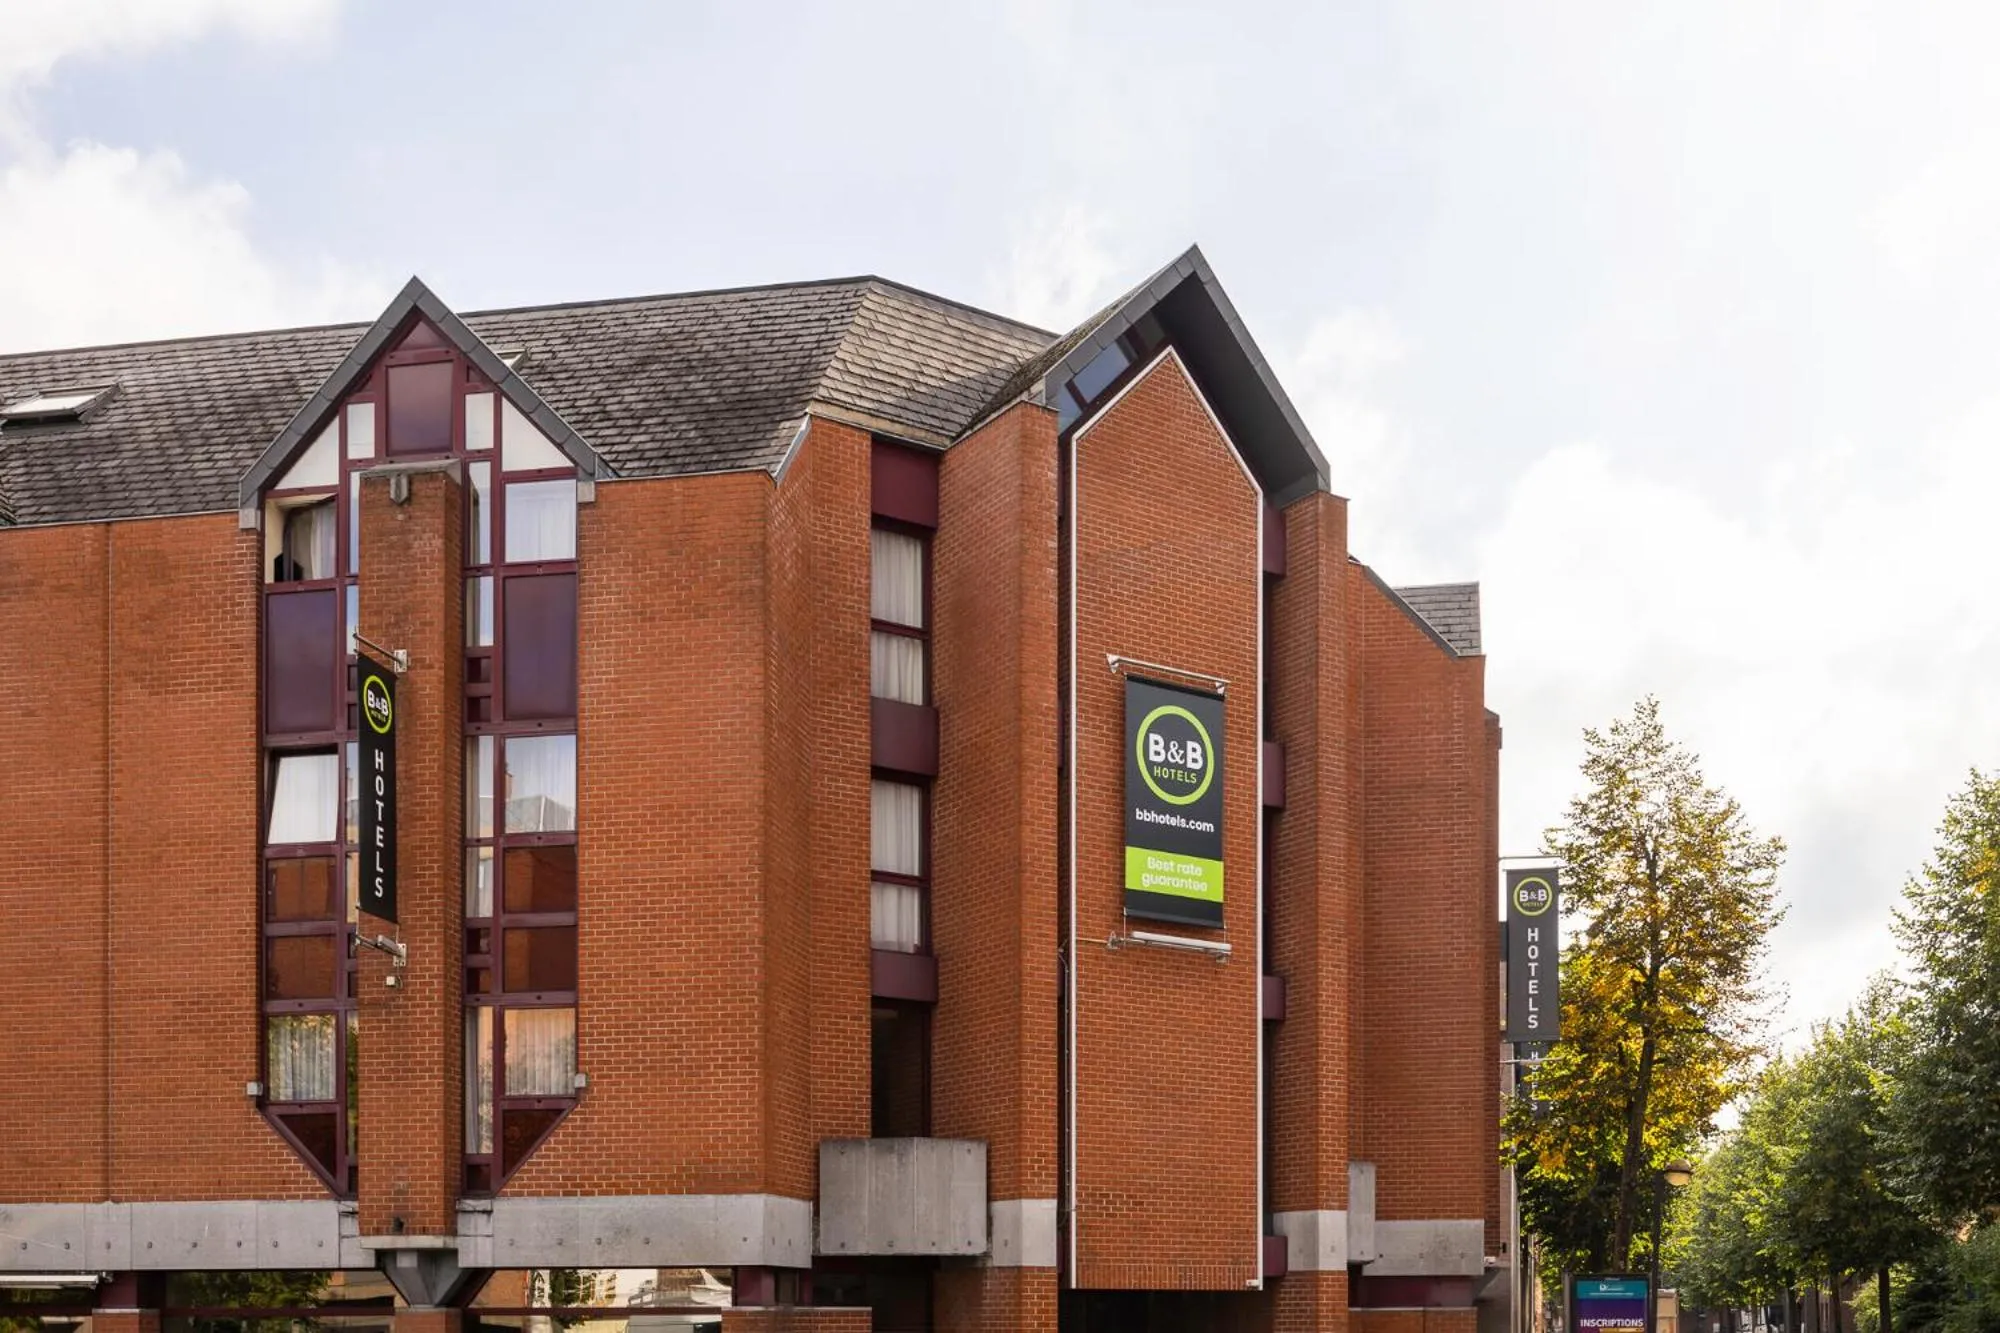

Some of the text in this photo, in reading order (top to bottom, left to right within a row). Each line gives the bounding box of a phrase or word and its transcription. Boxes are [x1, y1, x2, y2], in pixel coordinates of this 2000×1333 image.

[367, 689, 389, 717] B&B
[1148, 733, 1204, 770] B&B
[1153, 765, 1197, 784] HOTELS
[374, 748, 385, 898] HOTELS
[1135, 808, 1214, 833] bbhotels.com
[1147, 856, 1202, 877] Best rate
[1142, 873, 1208, 892] guarantee
[1519, 888, 1548, 902] B&B
[1527, 927, 1539, 1029] HOTELS
[1580, 1318, 1644, 1327] INSCRIPTIONS
